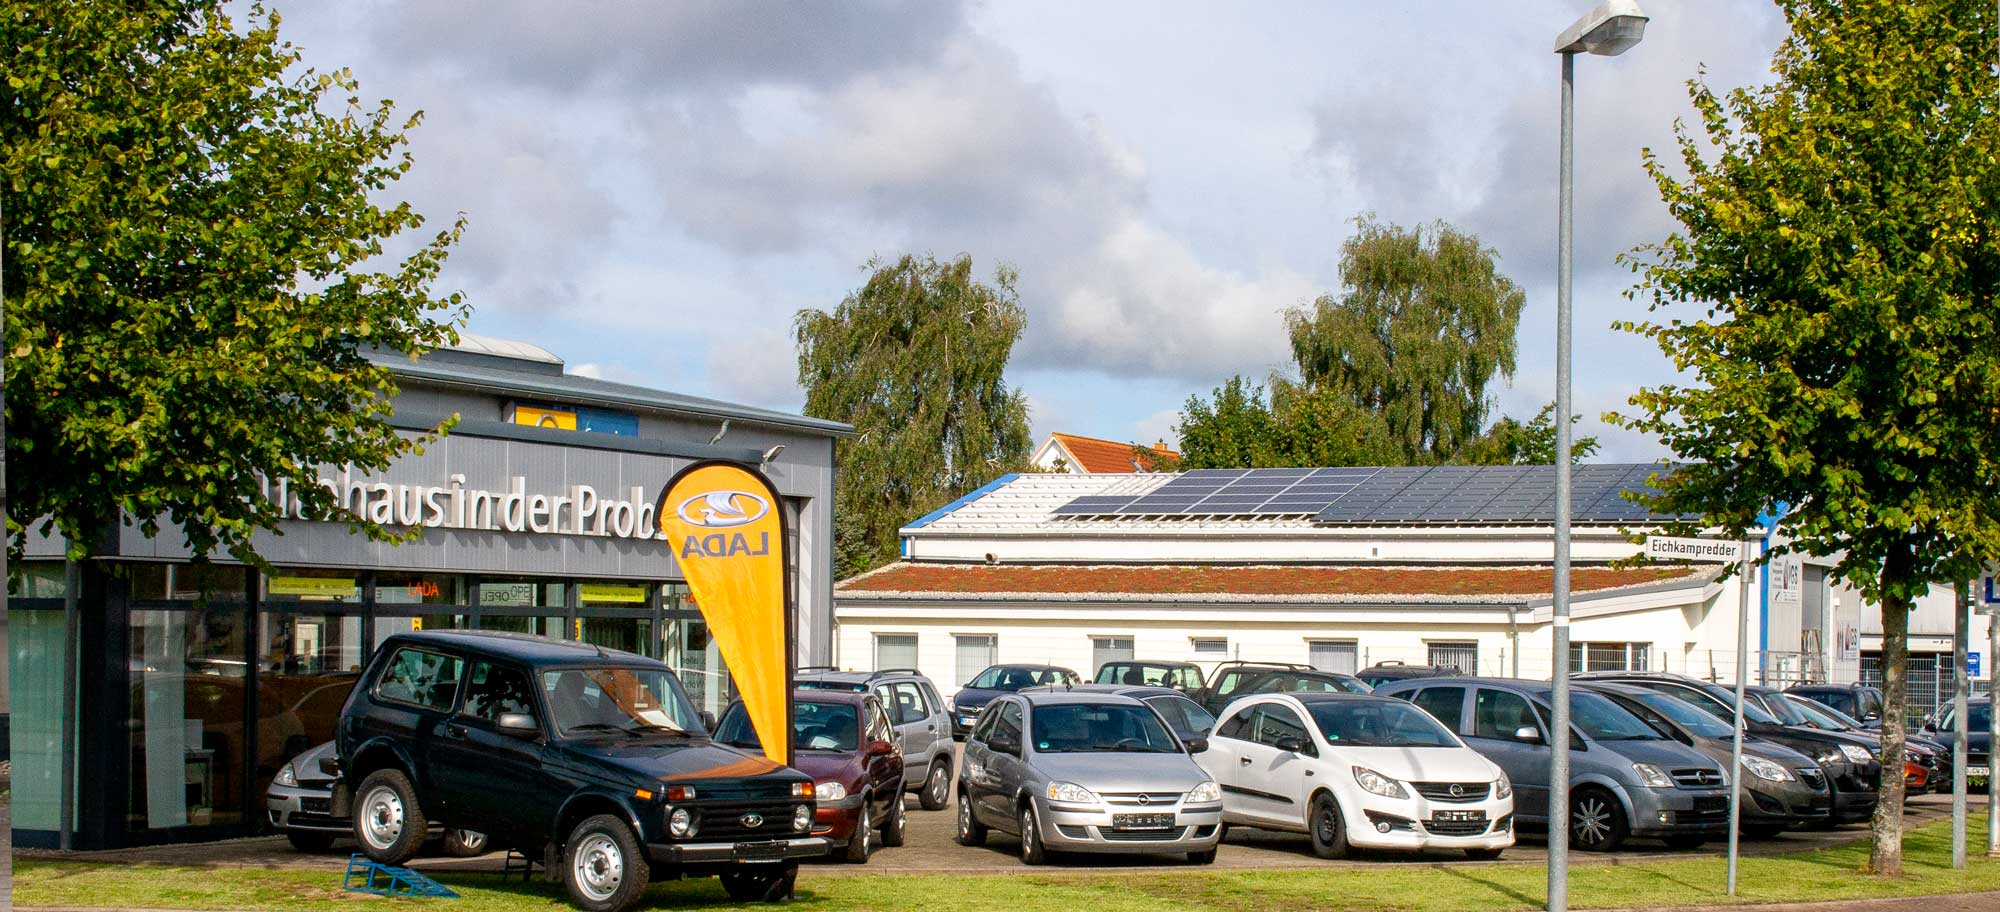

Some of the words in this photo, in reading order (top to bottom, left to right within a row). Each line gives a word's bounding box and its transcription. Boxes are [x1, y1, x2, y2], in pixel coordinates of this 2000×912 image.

[451, 474, 491, 529] in
[503, 476, 567, 533] der
[573, 485, 668, 540] Prob
[1652, 539, 1737, 557] Eichkampredder
[408, 582, 439, 597] LADA
[511, 585, 530, 599] OPE
